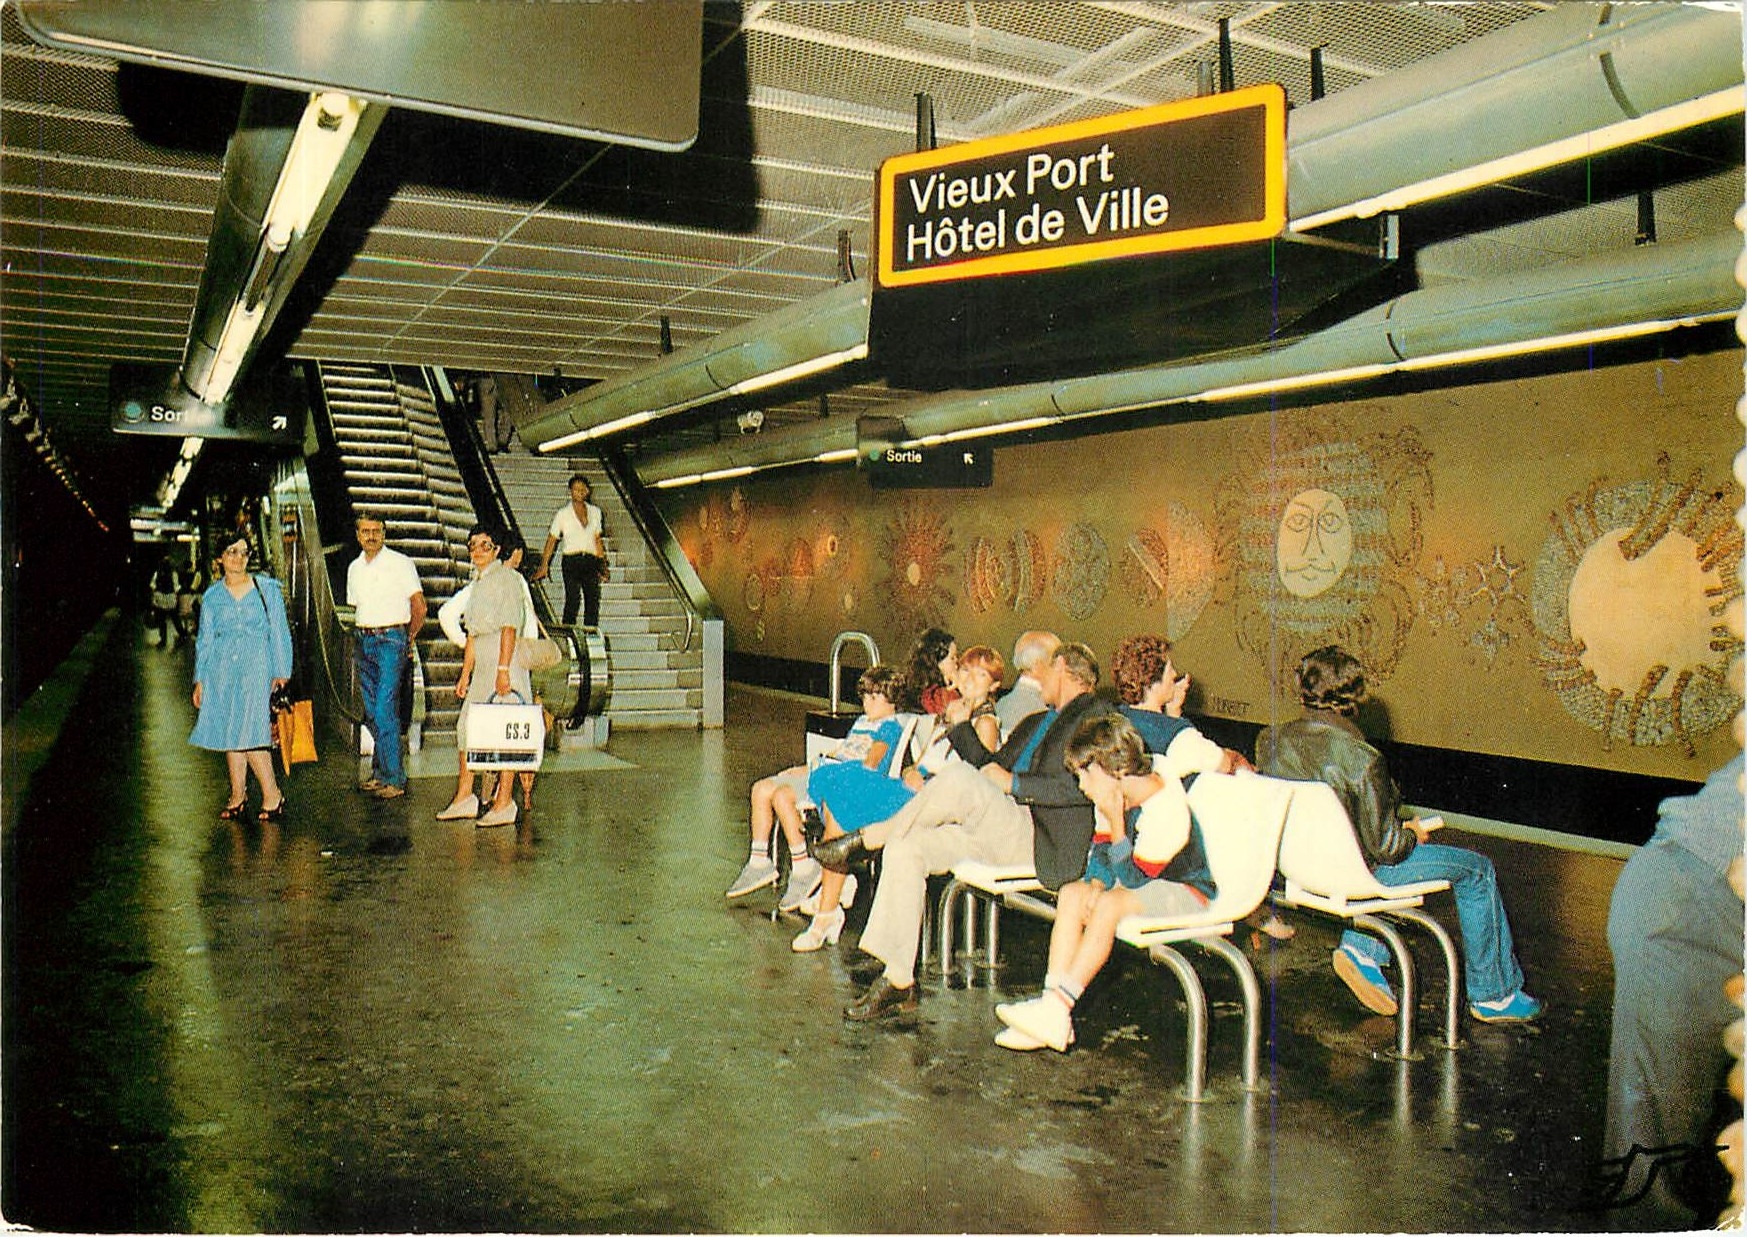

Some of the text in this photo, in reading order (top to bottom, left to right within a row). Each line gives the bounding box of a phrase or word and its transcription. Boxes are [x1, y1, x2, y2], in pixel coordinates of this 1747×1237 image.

[909, 143, 1115, 214] Vieux Port
[906, 186, 1169, 262] Hôtel de Ville
[886, 449, 922, 463] Sortie
